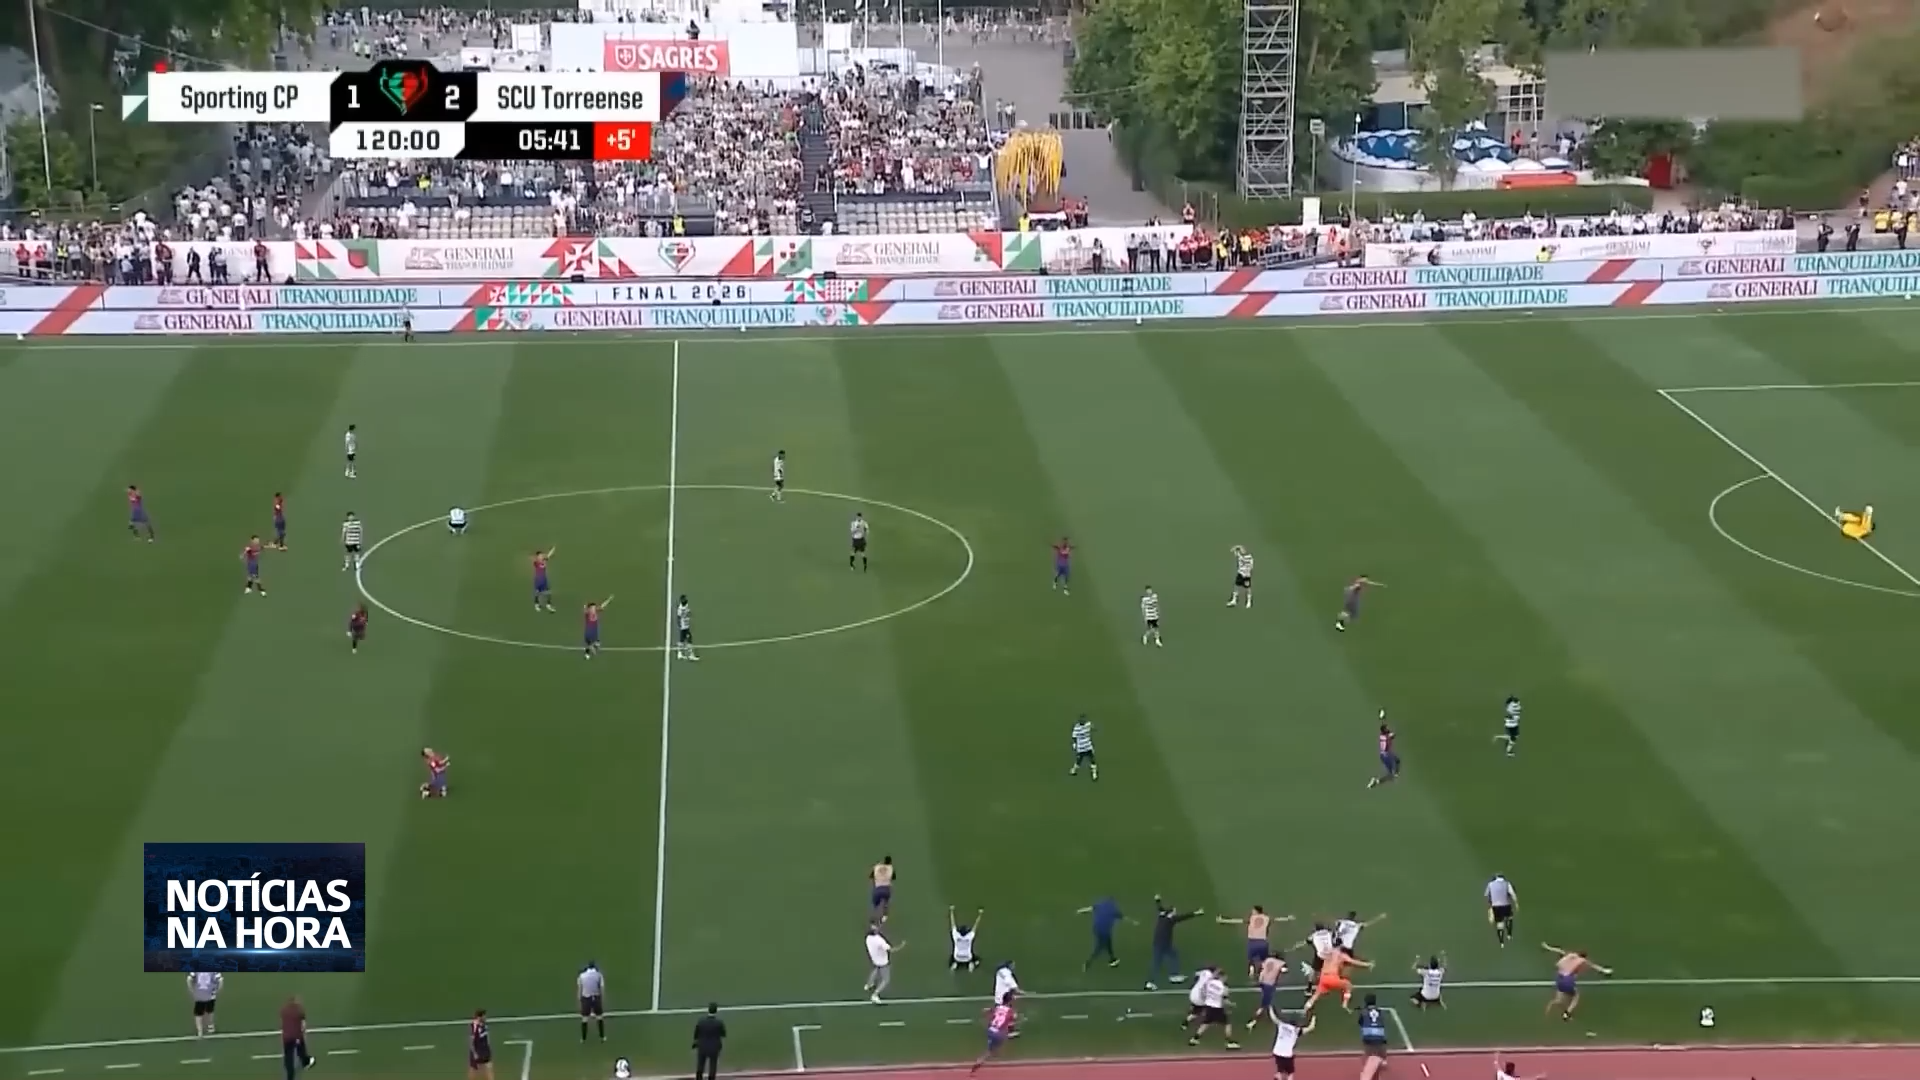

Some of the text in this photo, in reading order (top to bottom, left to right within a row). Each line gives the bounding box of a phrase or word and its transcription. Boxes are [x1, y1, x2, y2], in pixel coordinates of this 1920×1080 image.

[638, 43, 718, 71] SAGRES
[444, 247, 513, 260] GENERALI
[873, 242, 940, 255] GENERALI
[1705, 257, 1785, 275] GENERALI
[1329, 265, 1544, 286] GENERALI TRANQUILIDADE
[279, 288, 418, 304] TRANQUILIDADE
[612, 286, 678, 300] FINAL
[960, 280, 1037, 296] GENERALI
[1735, 280, 1819, 298] GENERALI
[1346, 289, 1568, 310] GENERALI TRANQUILIDADE
[553, 307, 795, 326] GENERALI TRANQUILIDADE
[965, 299, 1184, 320] GENERALI TRANQUILIDADE
[164, 314, 253, 330] GENERALI
